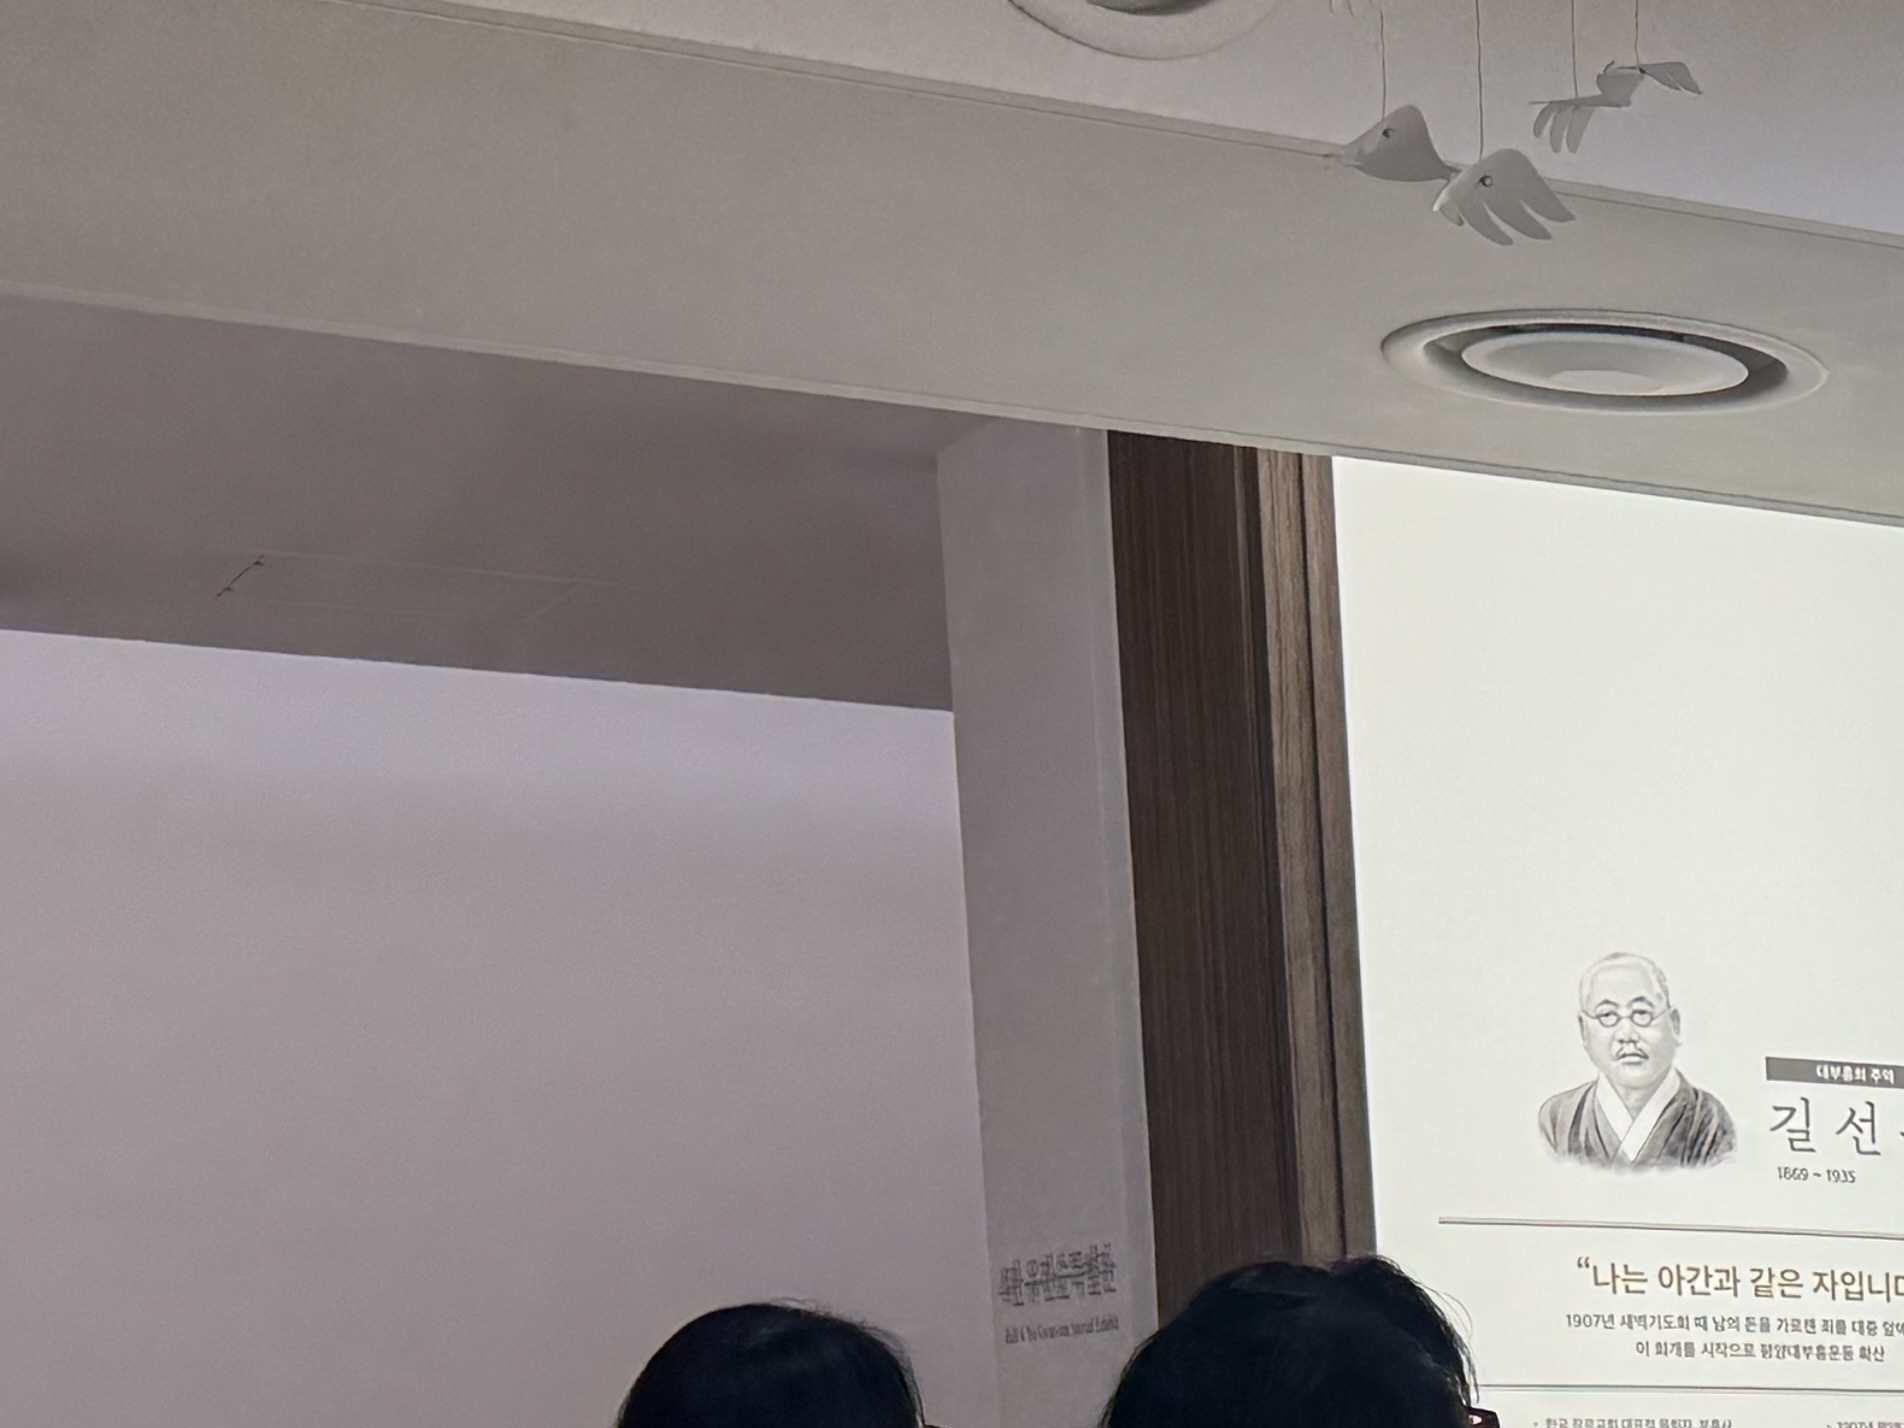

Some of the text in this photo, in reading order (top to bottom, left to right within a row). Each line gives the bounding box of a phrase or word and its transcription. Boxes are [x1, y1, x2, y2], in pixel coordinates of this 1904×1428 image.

[1826, 1169, 1856, 1183] 1935
[1577, 1257, 1648, 1294] “나는
[1658, 1264, 1741, 1298] 아간과
[1750, 1267, 1803, 1299] 같은
[1566, 1314, 1615, 1329] 1907년
[1620, 1314, 1690, 1331] 새벽기도회
[1712, 1316, 1740, 1332] 남의
[1636, 1341, 1649, 1357] 이
[1701, 1342, 1756, 1358] 시작으로
